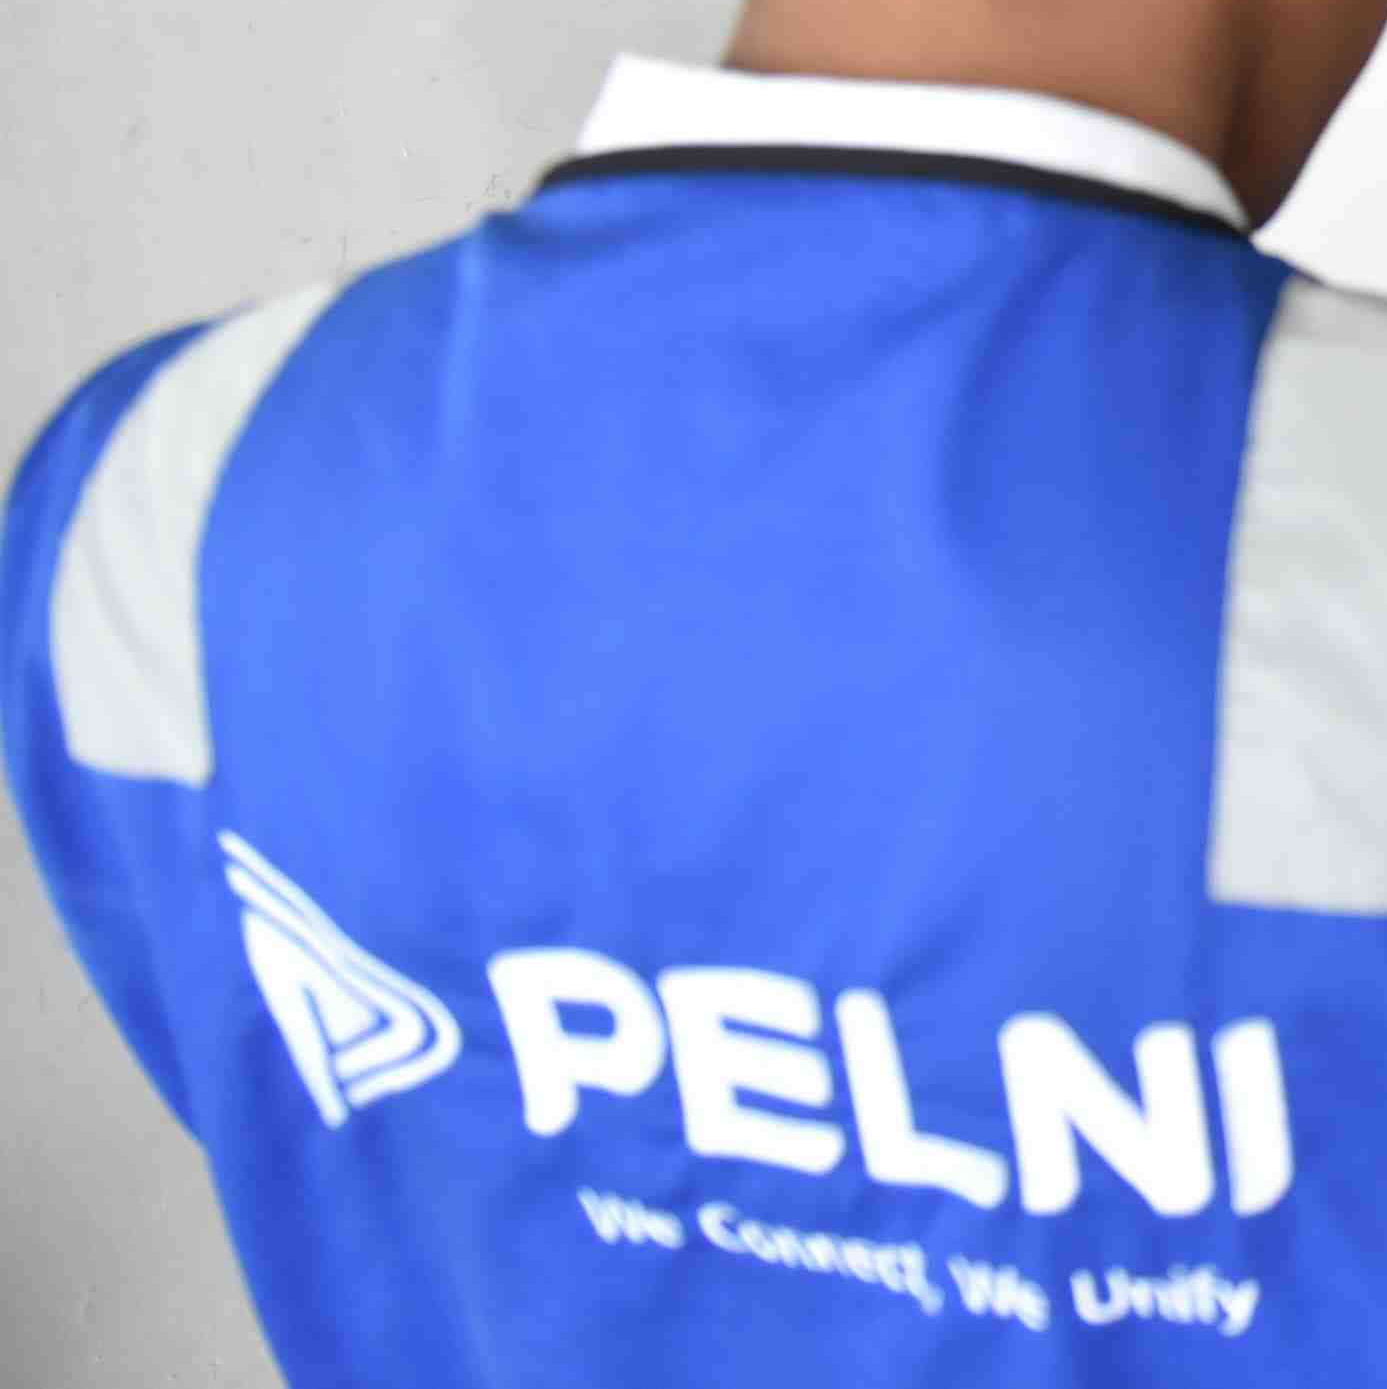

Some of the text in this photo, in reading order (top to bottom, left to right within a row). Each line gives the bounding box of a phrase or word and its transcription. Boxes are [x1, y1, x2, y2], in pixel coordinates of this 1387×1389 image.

[487, 947, 1294, 1217] PELNI
[576, 1185, 686, 1250] We
[947, 1252, 1050, 1332] We
[1069, 1263, 1262, 1337] Unify
